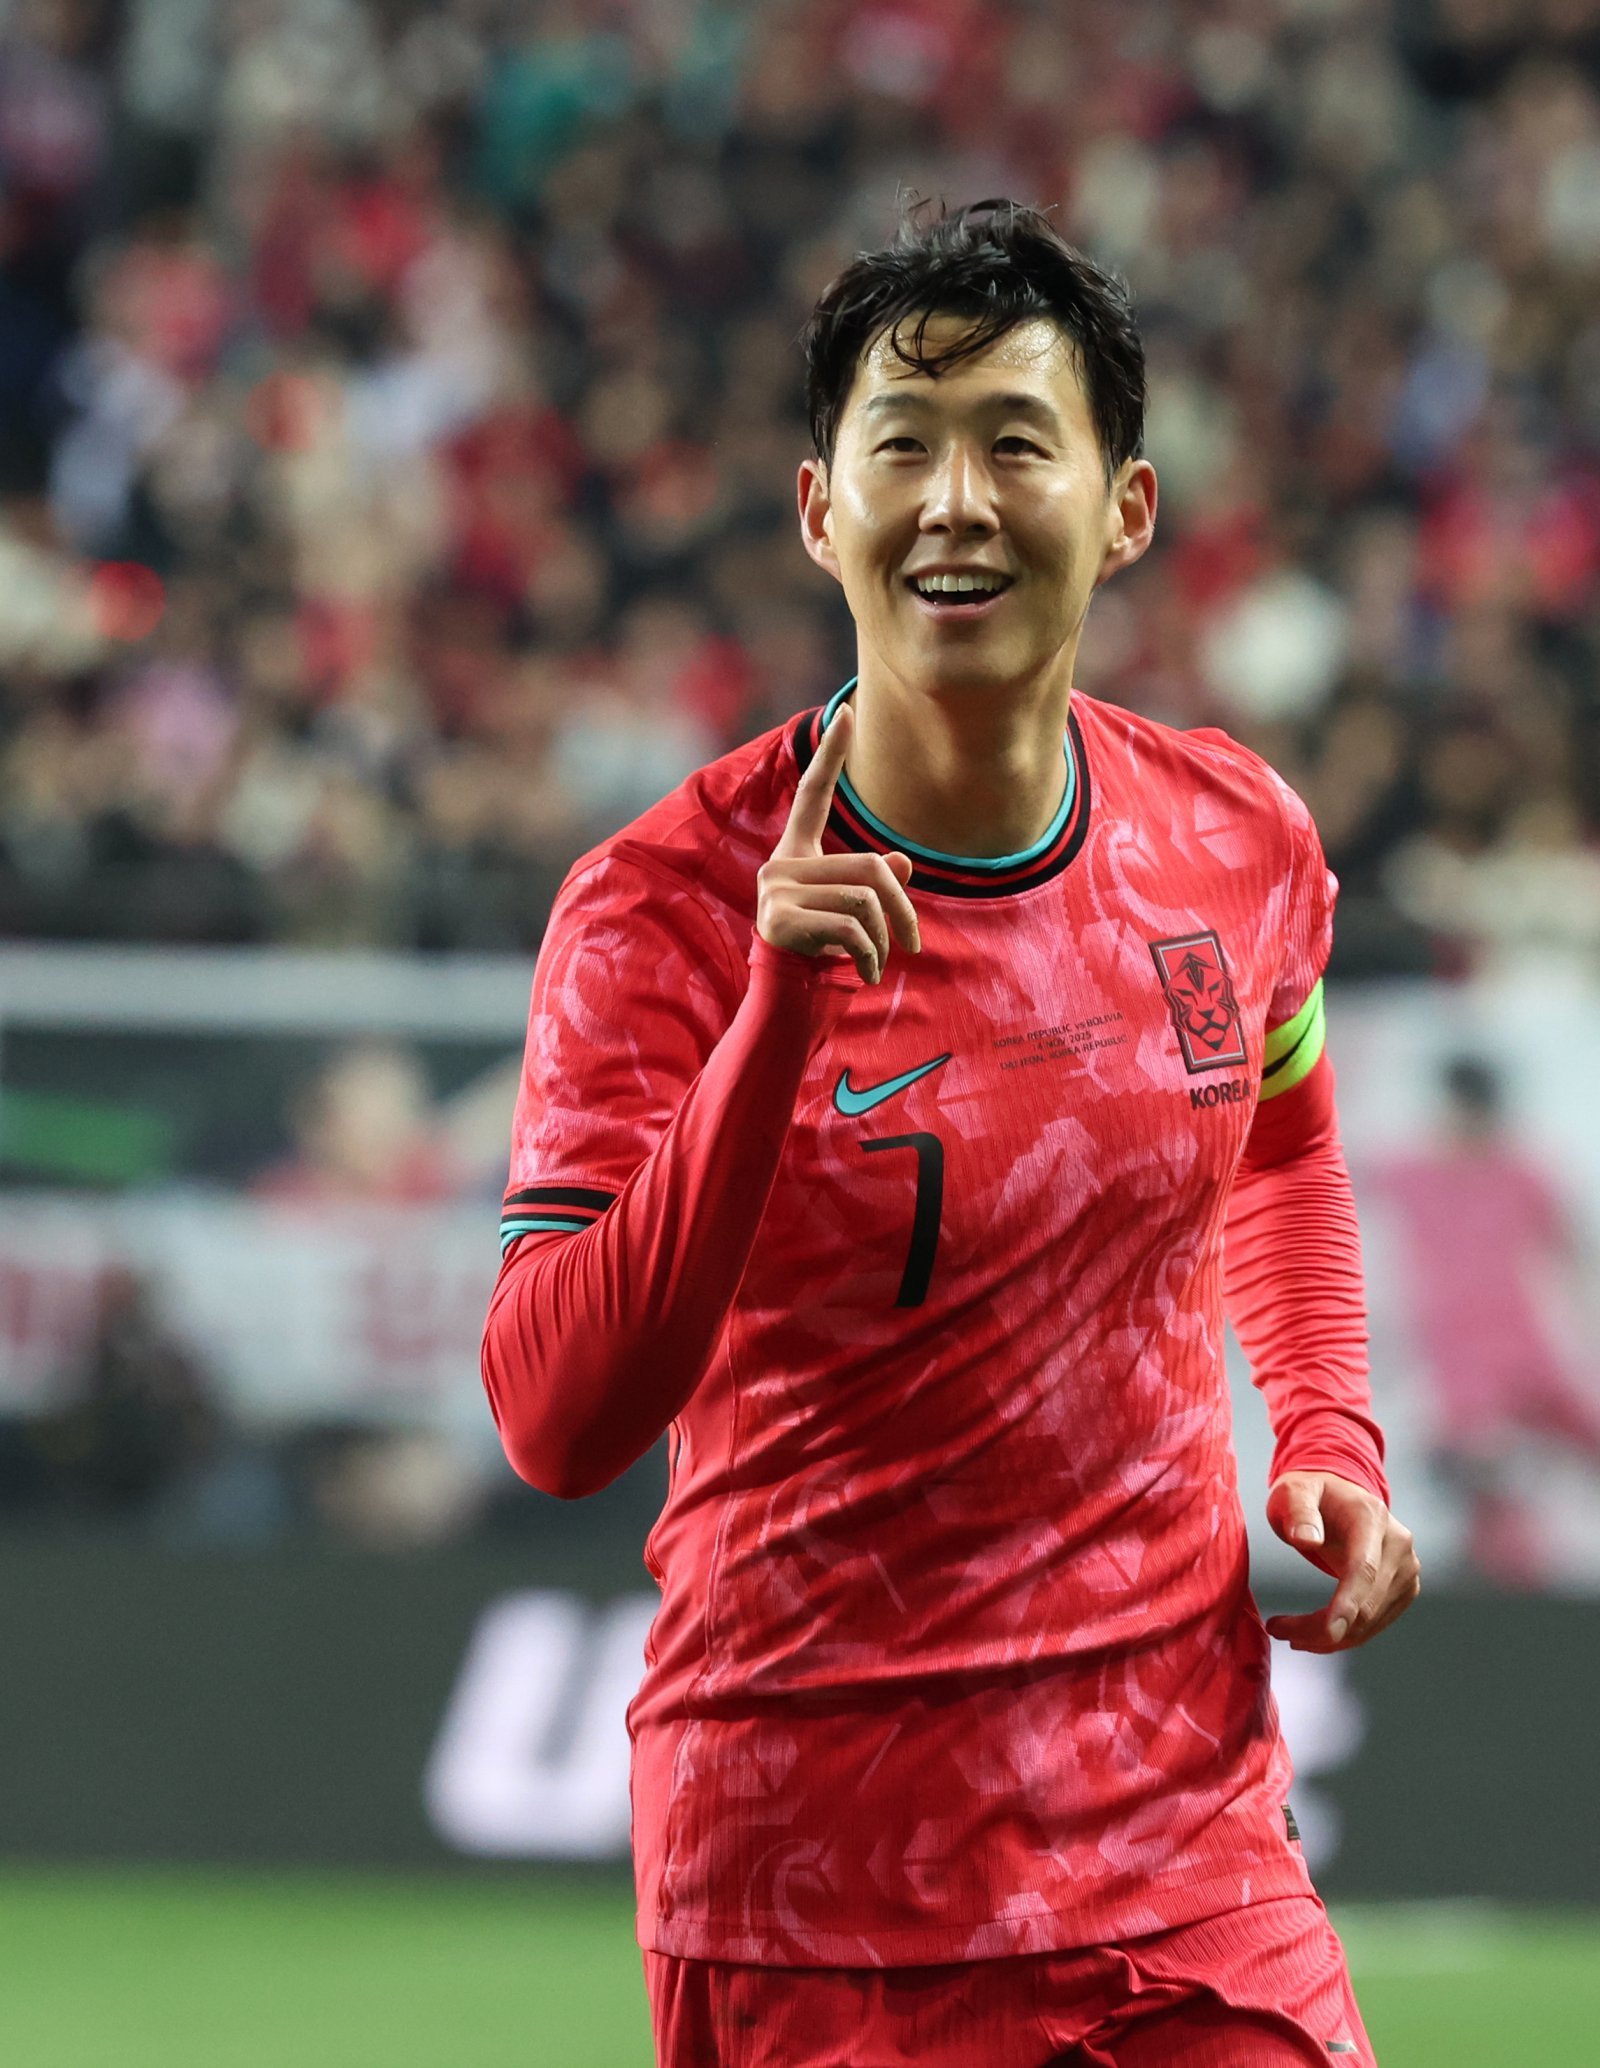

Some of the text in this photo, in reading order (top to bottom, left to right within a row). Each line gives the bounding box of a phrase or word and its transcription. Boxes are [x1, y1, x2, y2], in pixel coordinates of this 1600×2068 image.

[993, 1035, 1024, 1049] KOREA
[1027, 1023, 1072, 1041] REPUBLIC
[1086, 1012, 1123, 1028] BOLIVIA
[1046, 1038, 1066, 1048] NOV
[1069, 1031, 1092, 1043] 2025
[1049, 1046, 1081, 1059] KOREA
[1082, 1034, 1127, 1053] REPUBLIC
[1190, 1078, 1250, 1110] KOREA
[858, 1131, 945, 1308] 7
